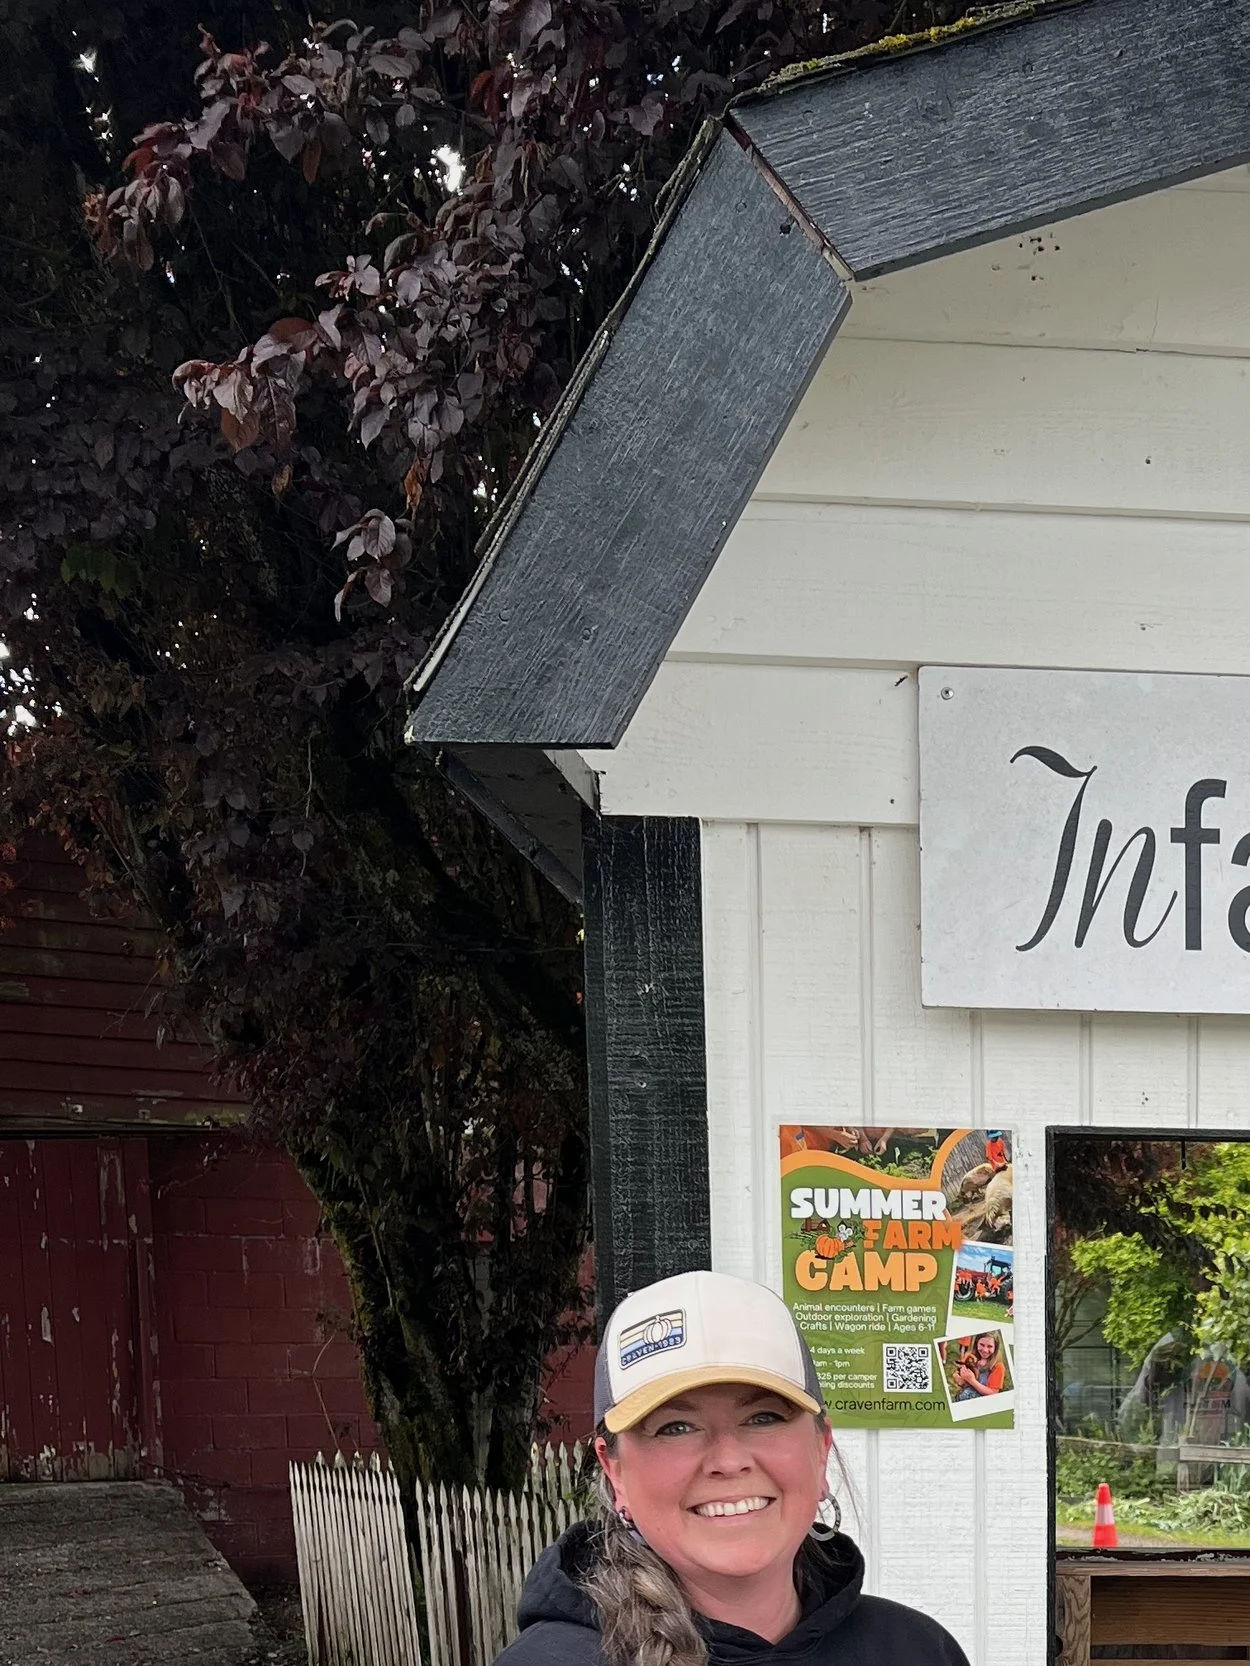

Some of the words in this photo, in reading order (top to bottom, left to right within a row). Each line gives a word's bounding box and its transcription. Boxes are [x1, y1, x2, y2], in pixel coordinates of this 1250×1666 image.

[790, 1188, 946, 1220] SUMMER
[862, 1220, 961, 1250] FARM
[795, 1250, 938, 1291] CAMP
[792, 1302, 822, 1312] Animal
[824, 1303, 875, 1312] encounters
[882, 1304, 905, 1313] Farm
[906, 1306, 937, 1315] games
[795, 1312, 832, 1321] Outdoor
[834, 1313, 885, 1323] exploration
[891, 1313, 937, 1323] Gardening
[799, 1321, 827, 1331] Crafts
[835, 1321, 867, 1333] Wagon
[868, 1321, 886, 1331] ride
[893, 1322, 917, 1333] Ages
[817, 1346, 836, 1356] days
[844, 1346, 865, 1354] week
[847, 1374, 877, 1382] camper
